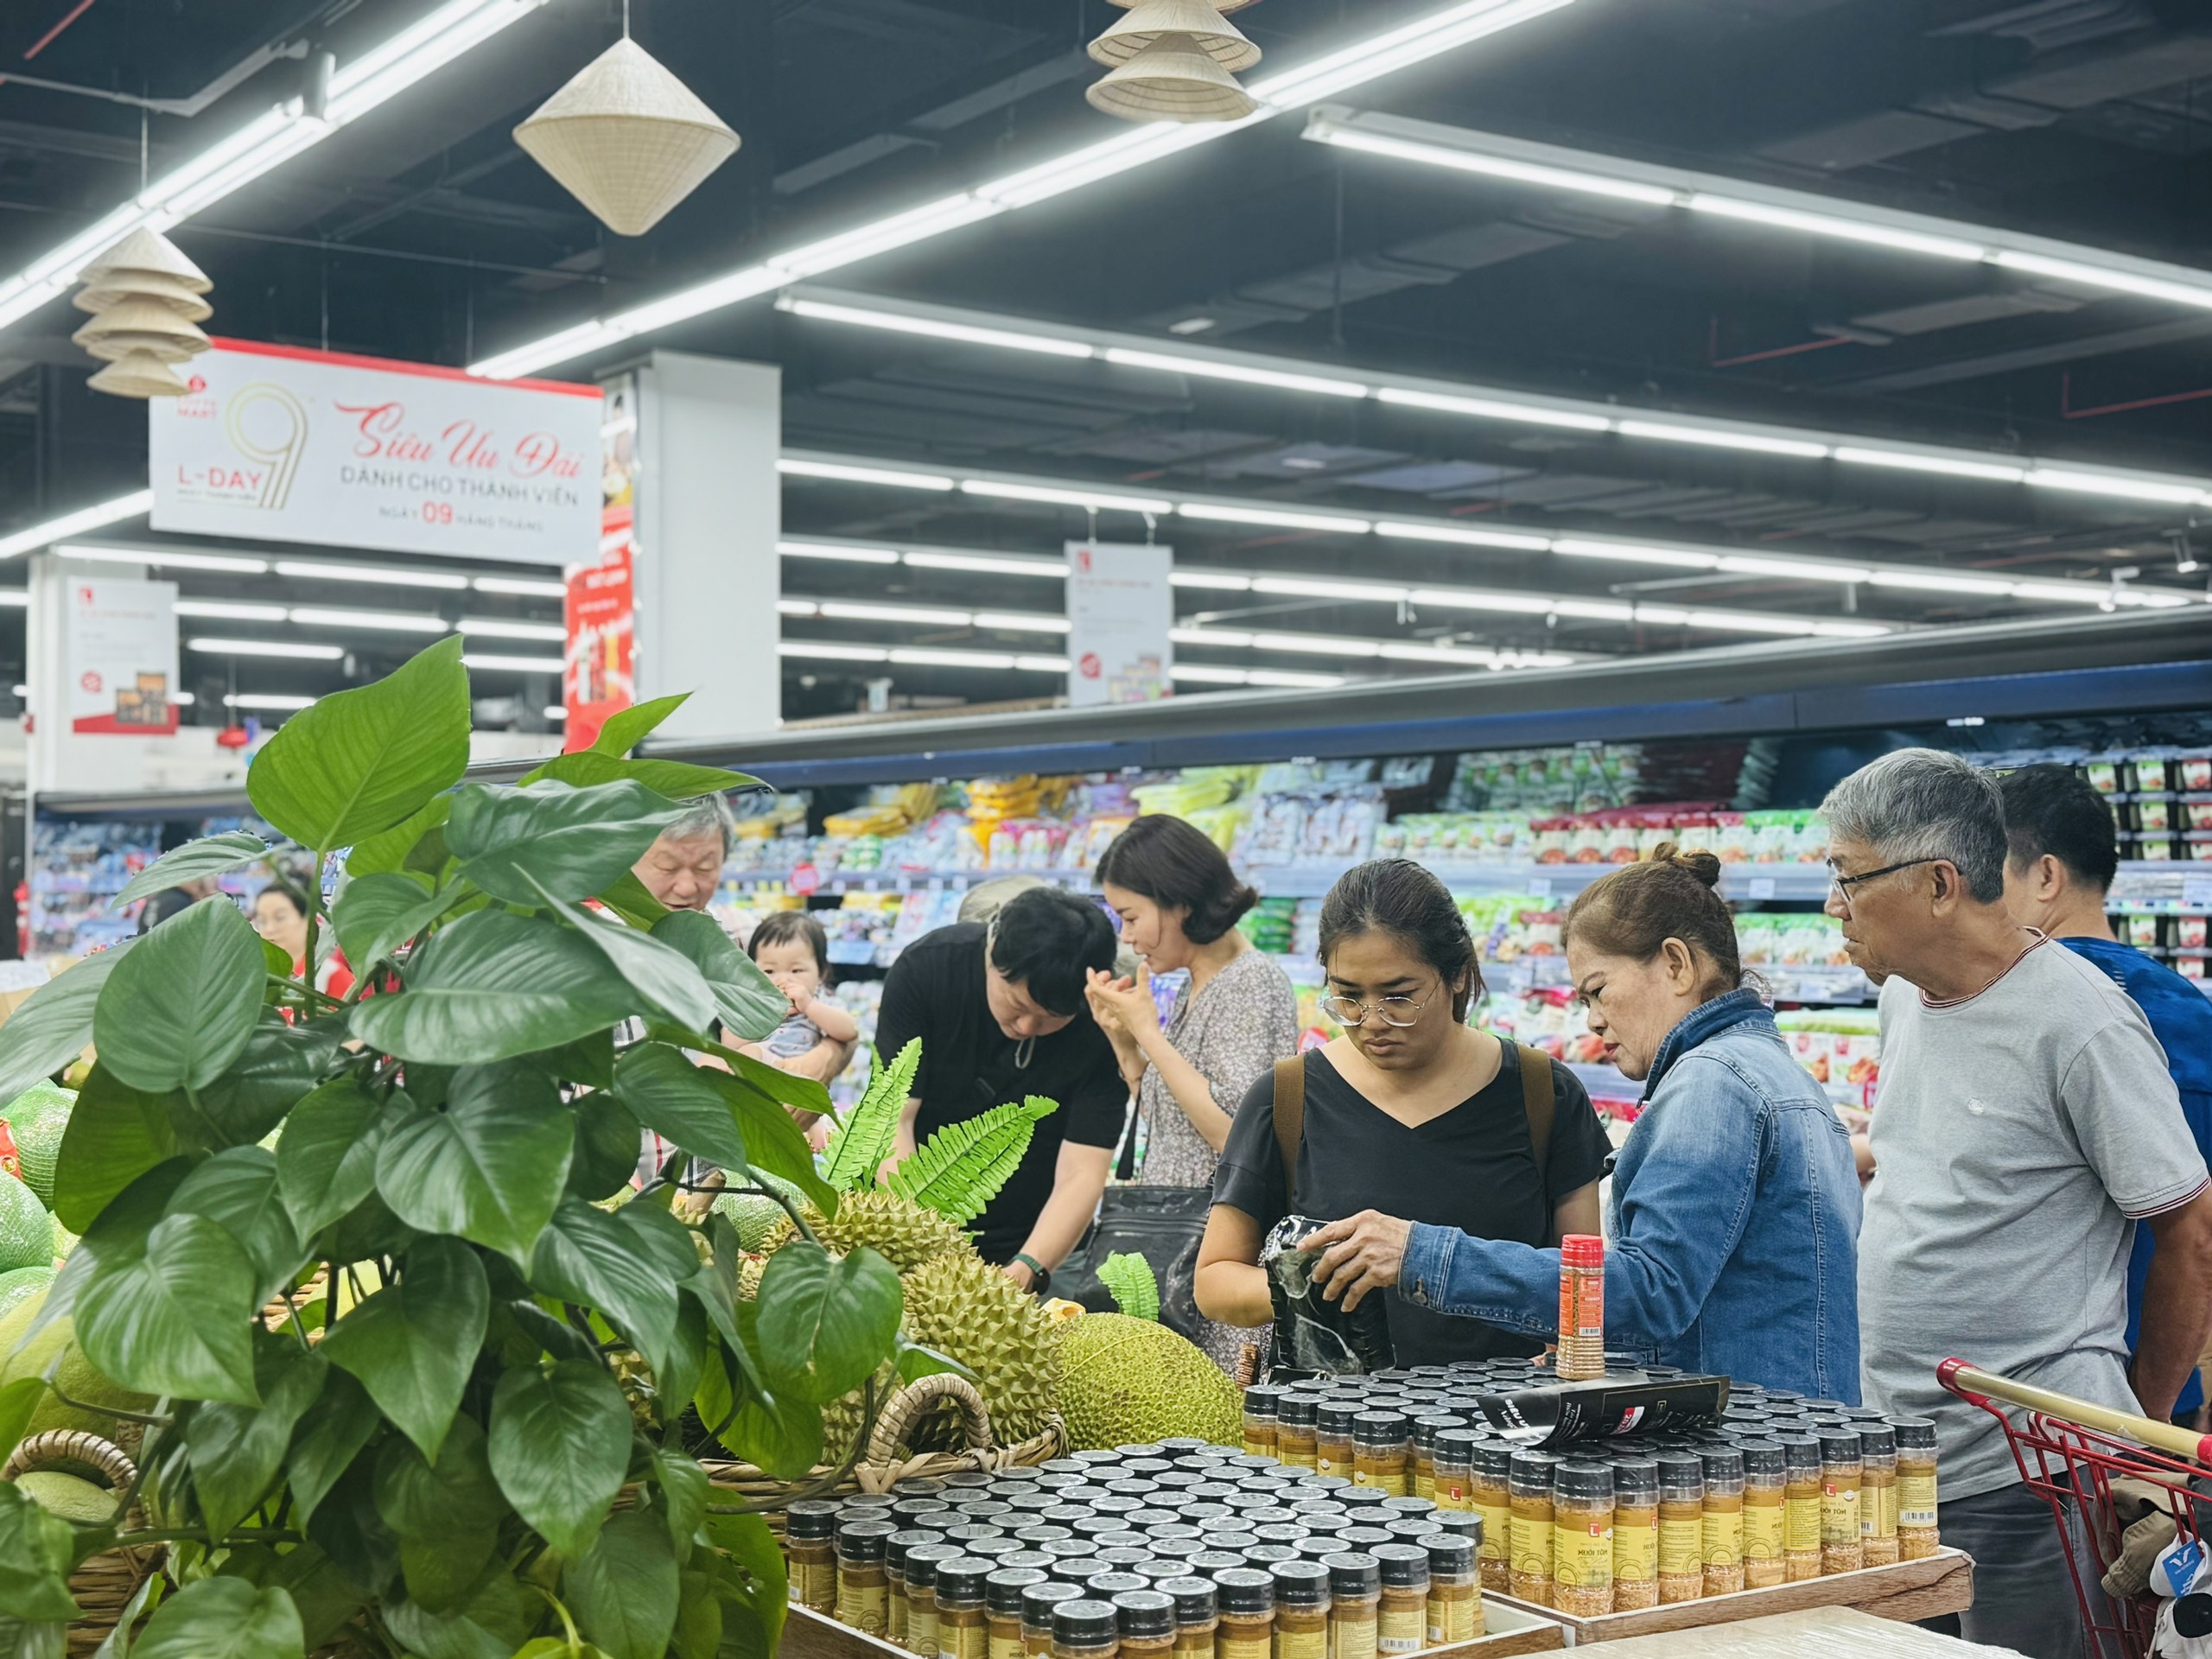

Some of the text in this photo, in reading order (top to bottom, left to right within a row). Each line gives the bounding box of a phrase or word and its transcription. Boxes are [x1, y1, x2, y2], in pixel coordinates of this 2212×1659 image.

[178, 463, 263, 492] L-DAY
[408, 472, 454, 494] CHO
[423, 501, 454, 524] 09
